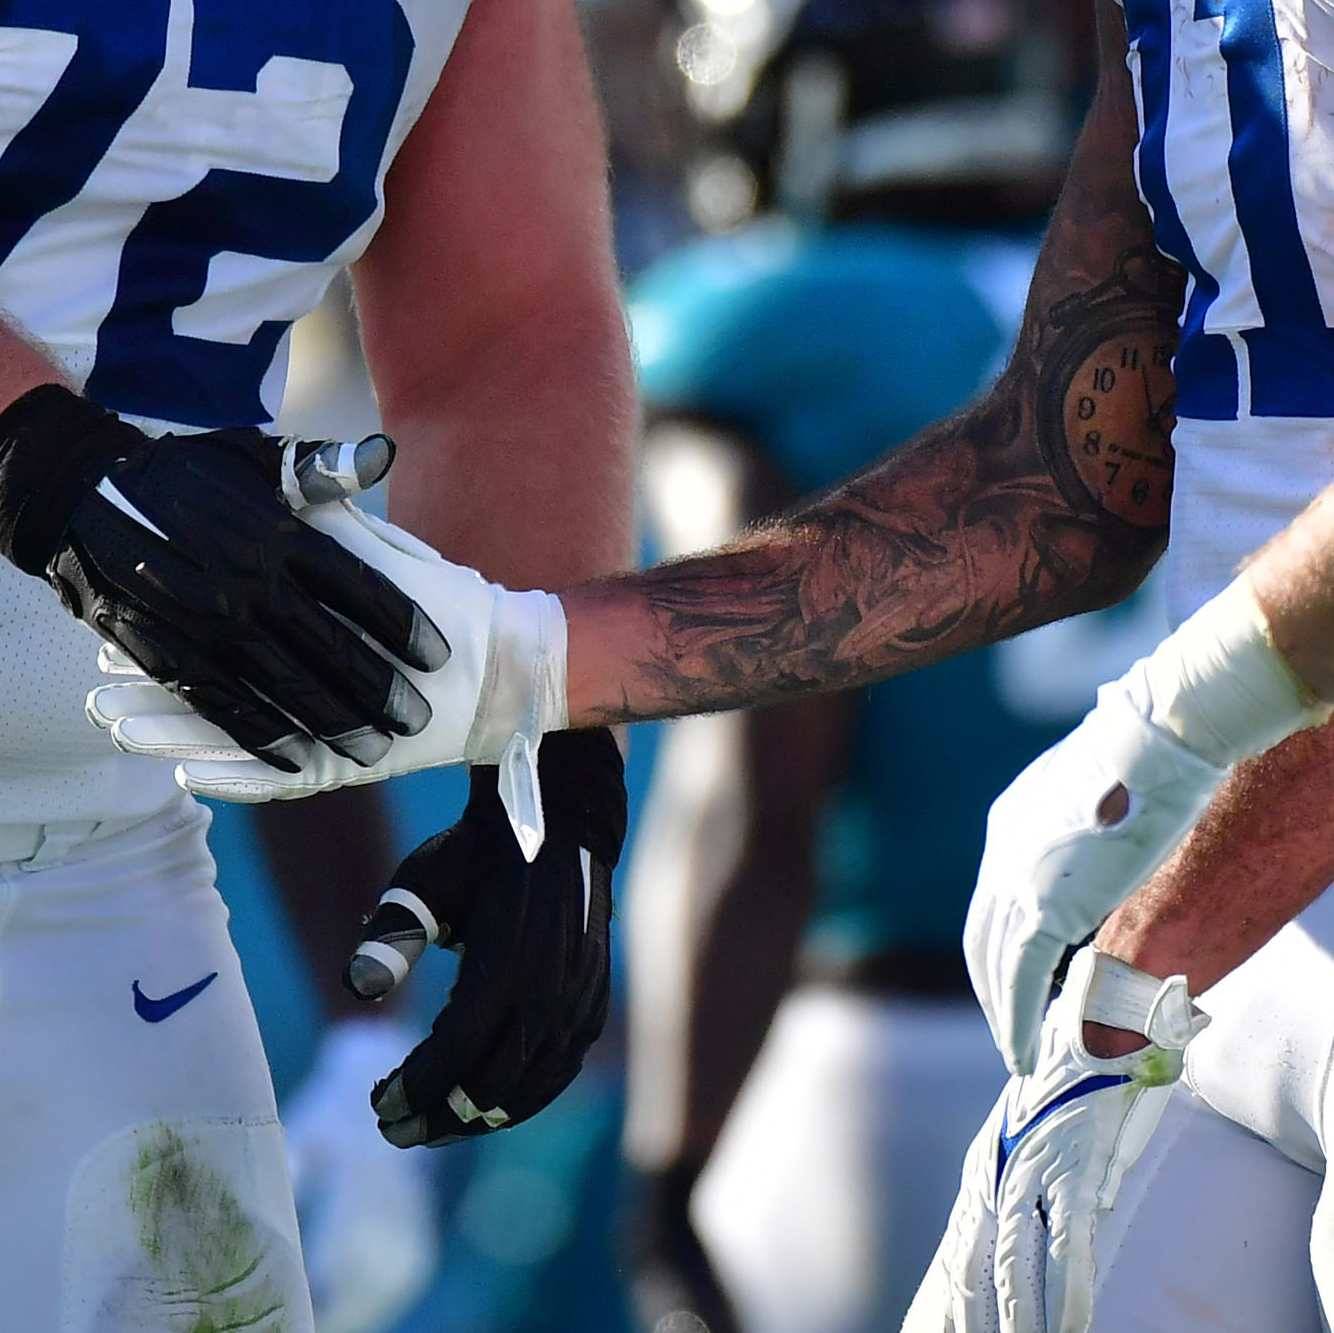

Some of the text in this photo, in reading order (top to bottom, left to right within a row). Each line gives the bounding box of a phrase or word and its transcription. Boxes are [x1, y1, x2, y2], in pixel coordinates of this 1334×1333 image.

[1121, 347, 1139, 371] 11
[1092, 367, 1116, 393] 10
[1077, 396, 1096, 421] 9
[1083, 430, 1100, 456] 8
[1105, 461, 1122, 485] 7
[1131, 478, 1151, 506] 6
